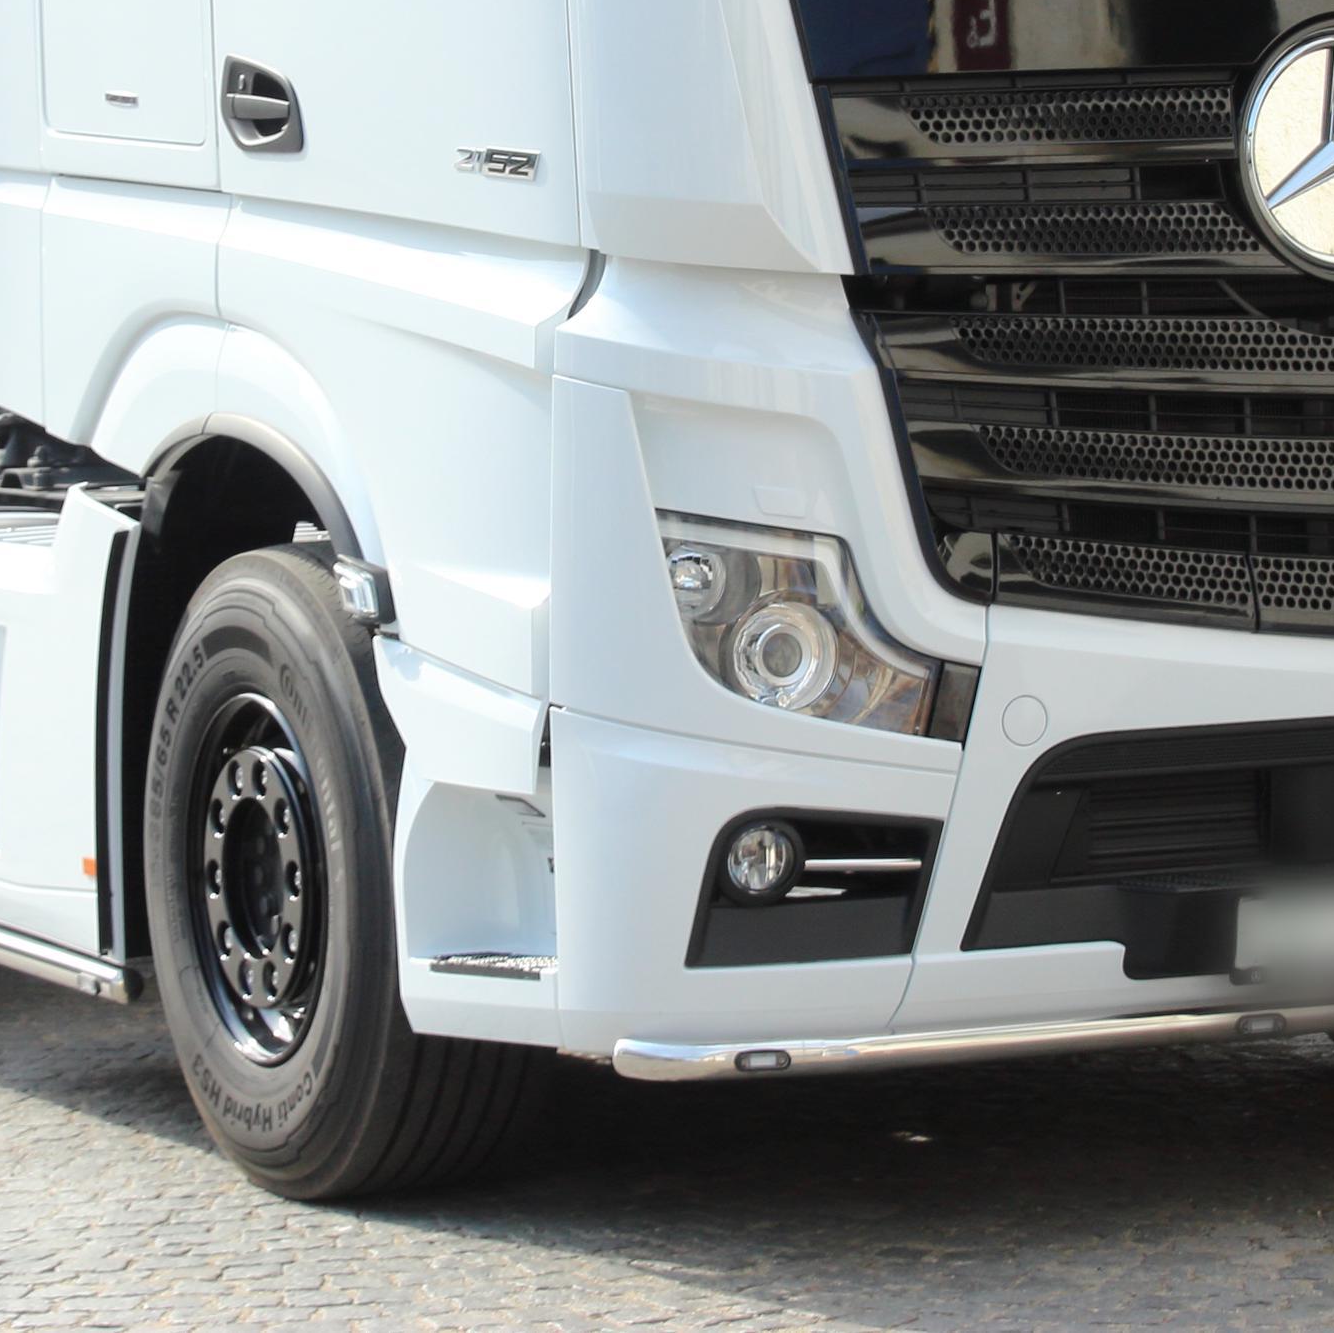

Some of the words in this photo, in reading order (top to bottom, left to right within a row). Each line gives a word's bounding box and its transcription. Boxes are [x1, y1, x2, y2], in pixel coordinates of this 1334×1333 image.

[166, 697, 180, 724] R
[175, 644, 205, 700] 22.5
[222, 1093, 273, 1133] Hybrid
[277, 1070, 314, 1129] Conti
